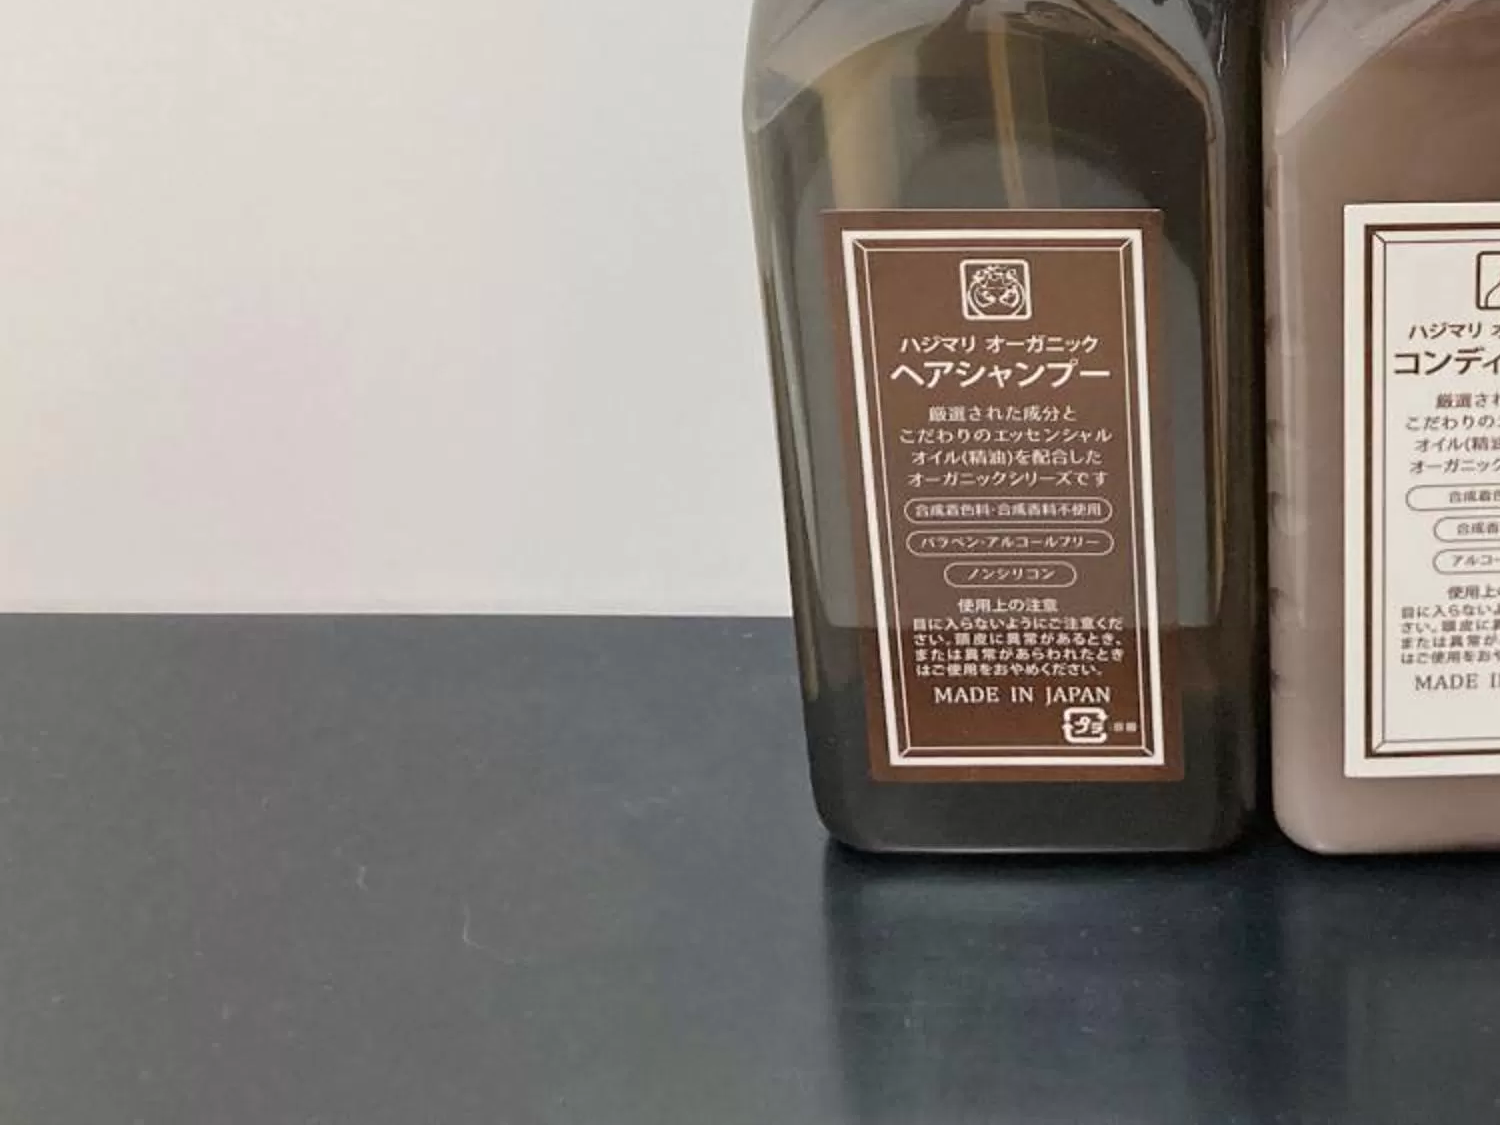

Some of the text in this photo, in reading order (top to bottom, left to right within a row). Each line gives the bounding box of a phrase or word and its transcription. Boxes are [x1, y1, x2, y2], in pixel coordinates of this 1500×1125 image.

[1409, 323, 1481, 340] ハジマリ
[900, 334, 1099, 353] ハジマリ オーガニック
[890, 359, 1111, 389] ヘアシャンプー
[928, 405, 1077, 422] 厳選された成分と
[899, 428, 1113, 444] こだわりのエッセンシャル
[907, 471, 1109, 488] オーガニックシリーズです
[966, 567, 1055, 582] ノンシリコン
[958, 598, 1058, 613] 使用上の注意
[1415, 674, 1479, 691] MADE
[934, 686, 1111, 706] MADE IN JAPAN
